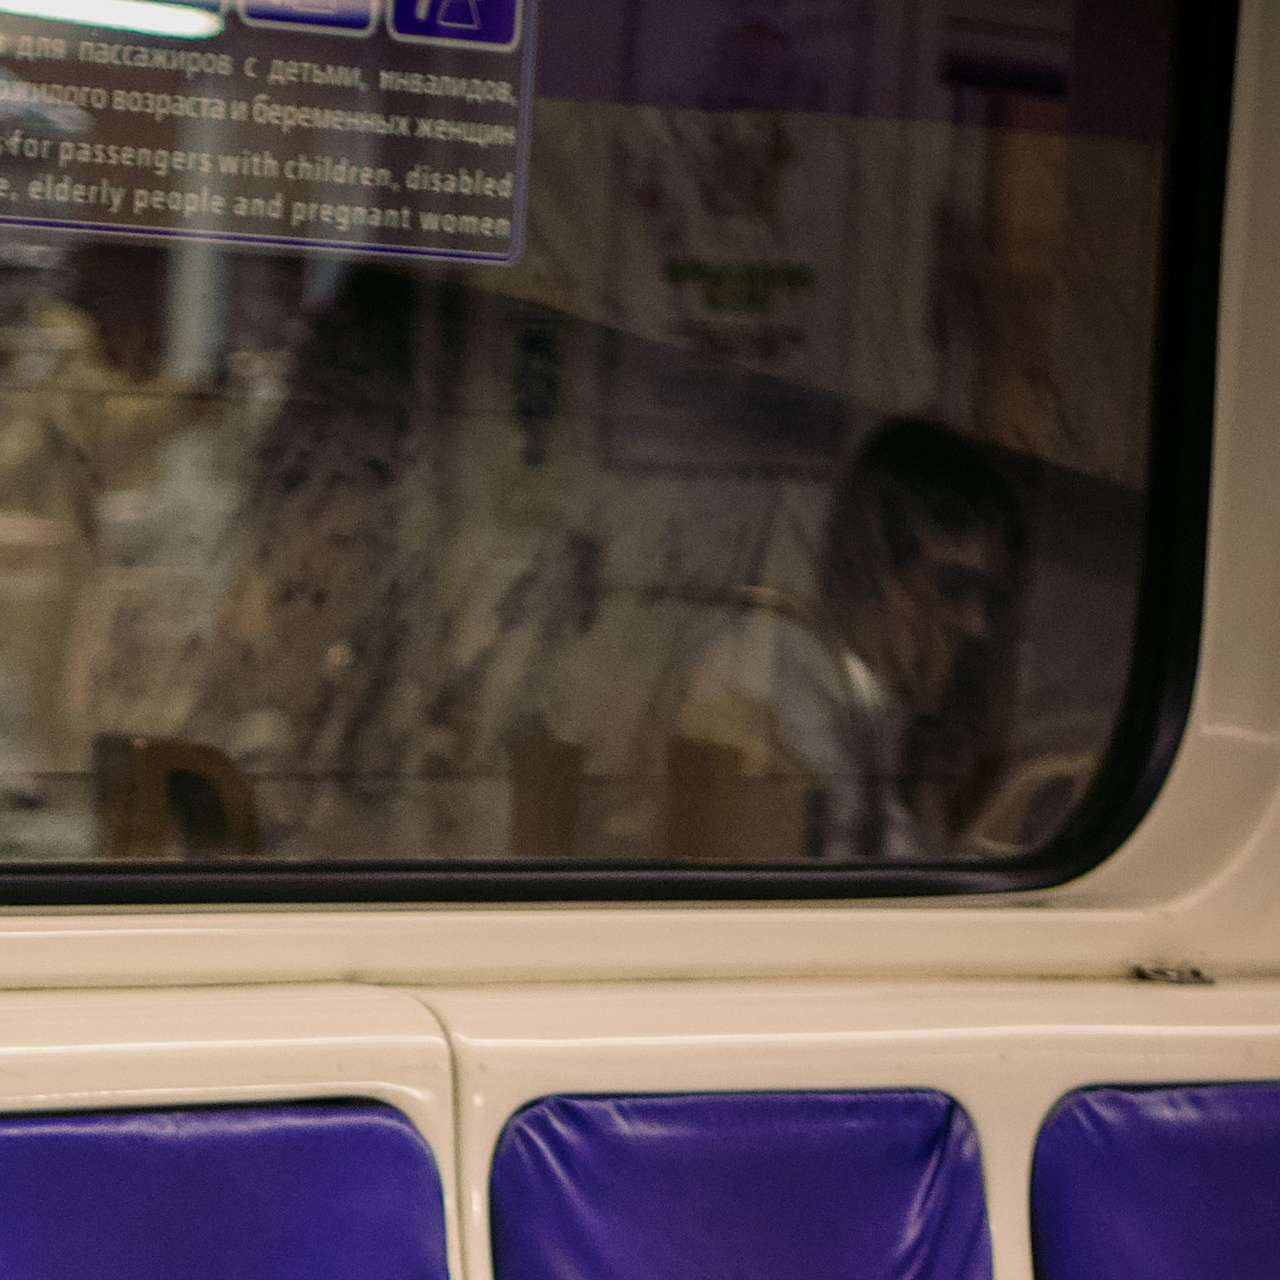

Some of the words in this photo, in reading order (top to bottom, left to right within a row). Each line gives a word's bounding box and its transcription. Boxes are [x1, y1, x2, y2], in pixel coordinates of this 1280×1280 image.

[16, 34, 68, 59] для
[78, 41, 234, 79] пассажиров
[243, 56, 259, 79] с
[267, 59, 368, 92] детьми,
[111, 89, 226, 121] возраста
[230, 100, 249, 122] и
[252, 93, 412, 136] беременных
[414, 117, 517, 148] женщин
[58, 140, 212, 176] passengers
[217, 149, 280, 179] with
[404, 163, 514, 199] disabled
[28, 172, 126, 214] elderly
[132, 184, 226, 219] people
[233, 193, 285, 221] and
[291, 200, 412, 232] pregnant
[418, 211, 513, 239] women
